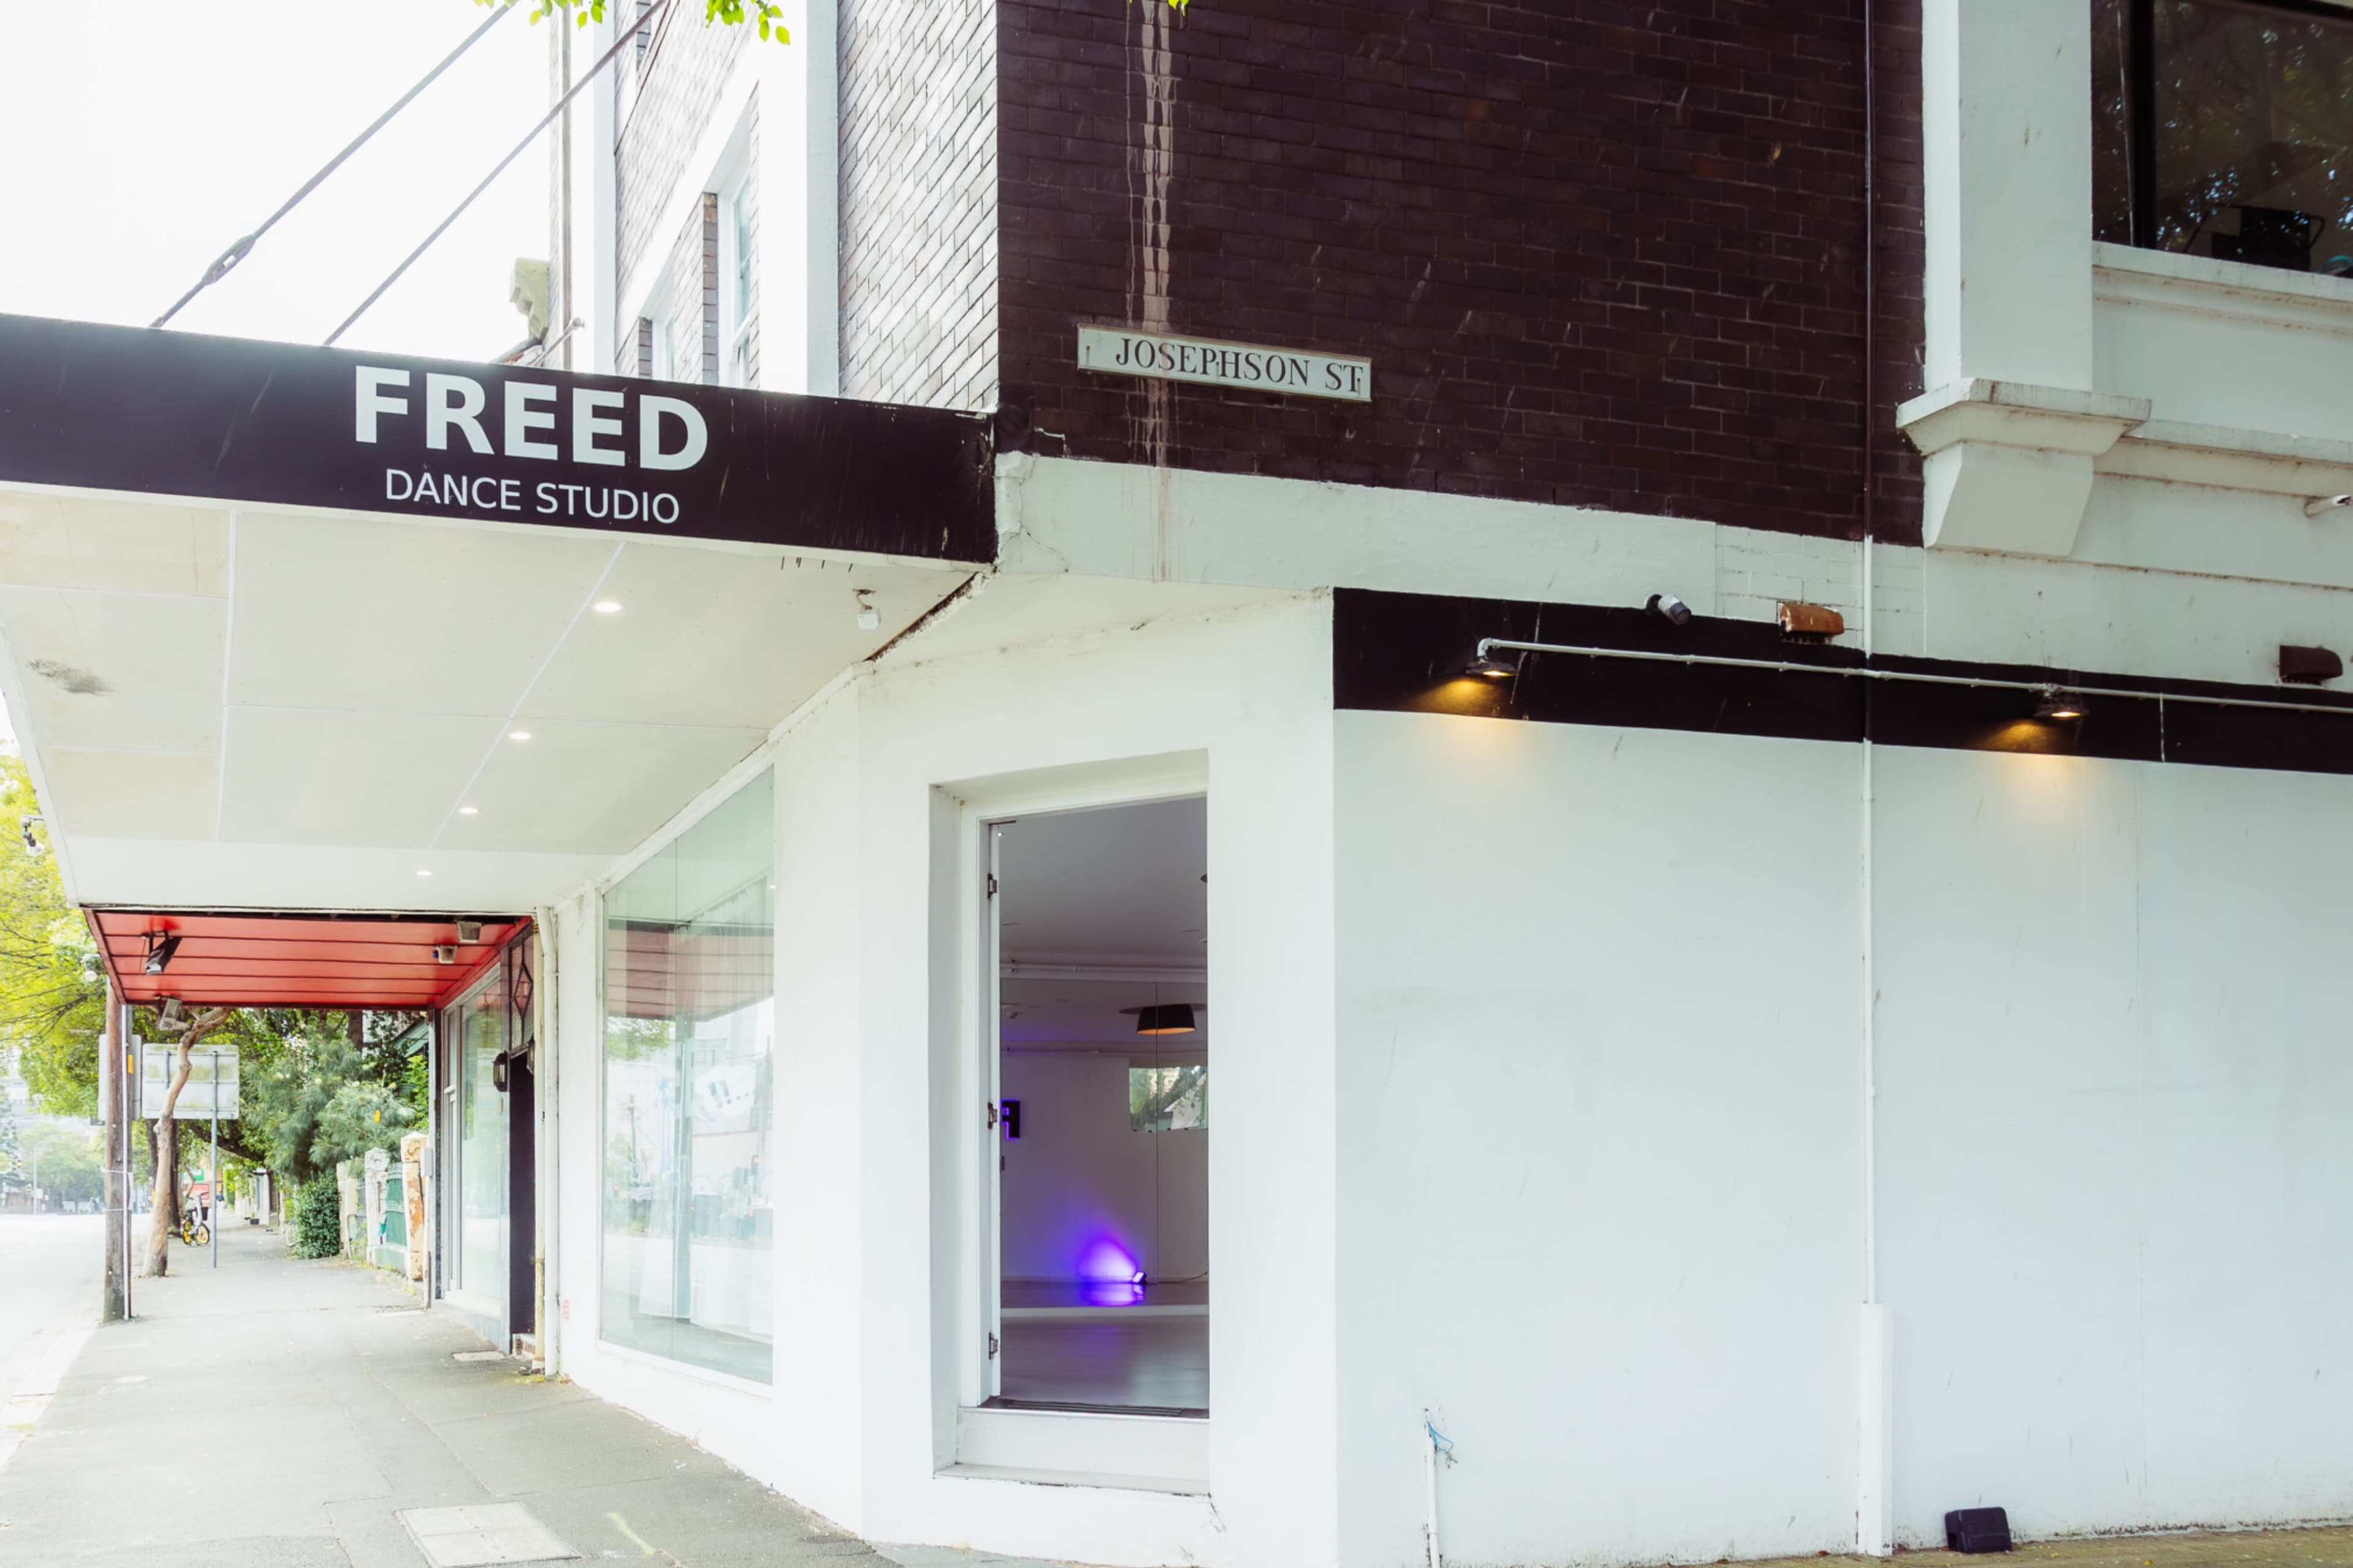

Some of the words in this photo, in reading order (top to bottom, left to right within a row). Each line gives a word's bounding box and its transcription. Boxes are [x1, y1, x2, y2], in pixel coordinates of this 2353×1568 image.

[1115, 338, 1311, 387] JOSEPHSON
[1325, 362, 1364, 393] ST
[355, 365, 708, 471] FREED
[386, 469, 521, 510] DANCE
[536, 482, 680, 523] STUDIO
